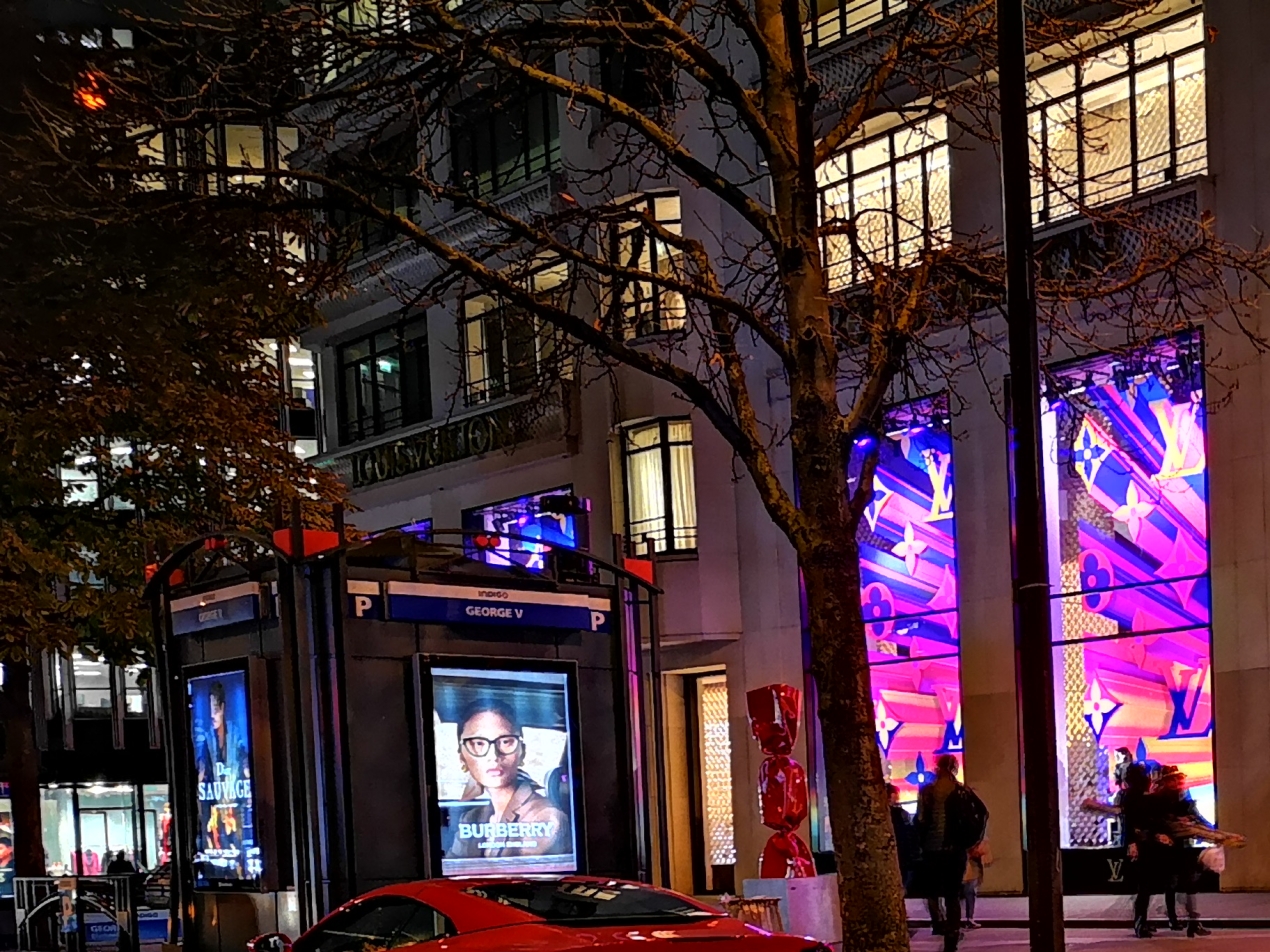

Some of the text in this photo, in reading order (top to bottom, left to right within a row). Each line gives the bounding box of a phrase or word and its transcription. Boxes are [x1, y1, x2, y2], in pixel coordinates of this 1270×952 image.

[355, 595, 373, 618] P
[465, 605, 524, 619] GEORGE V
[589, 611, 606, 632] P
[198, 779, 252, 801] SAUVAGE
[458, 821, 556, 839] BURBERRY
